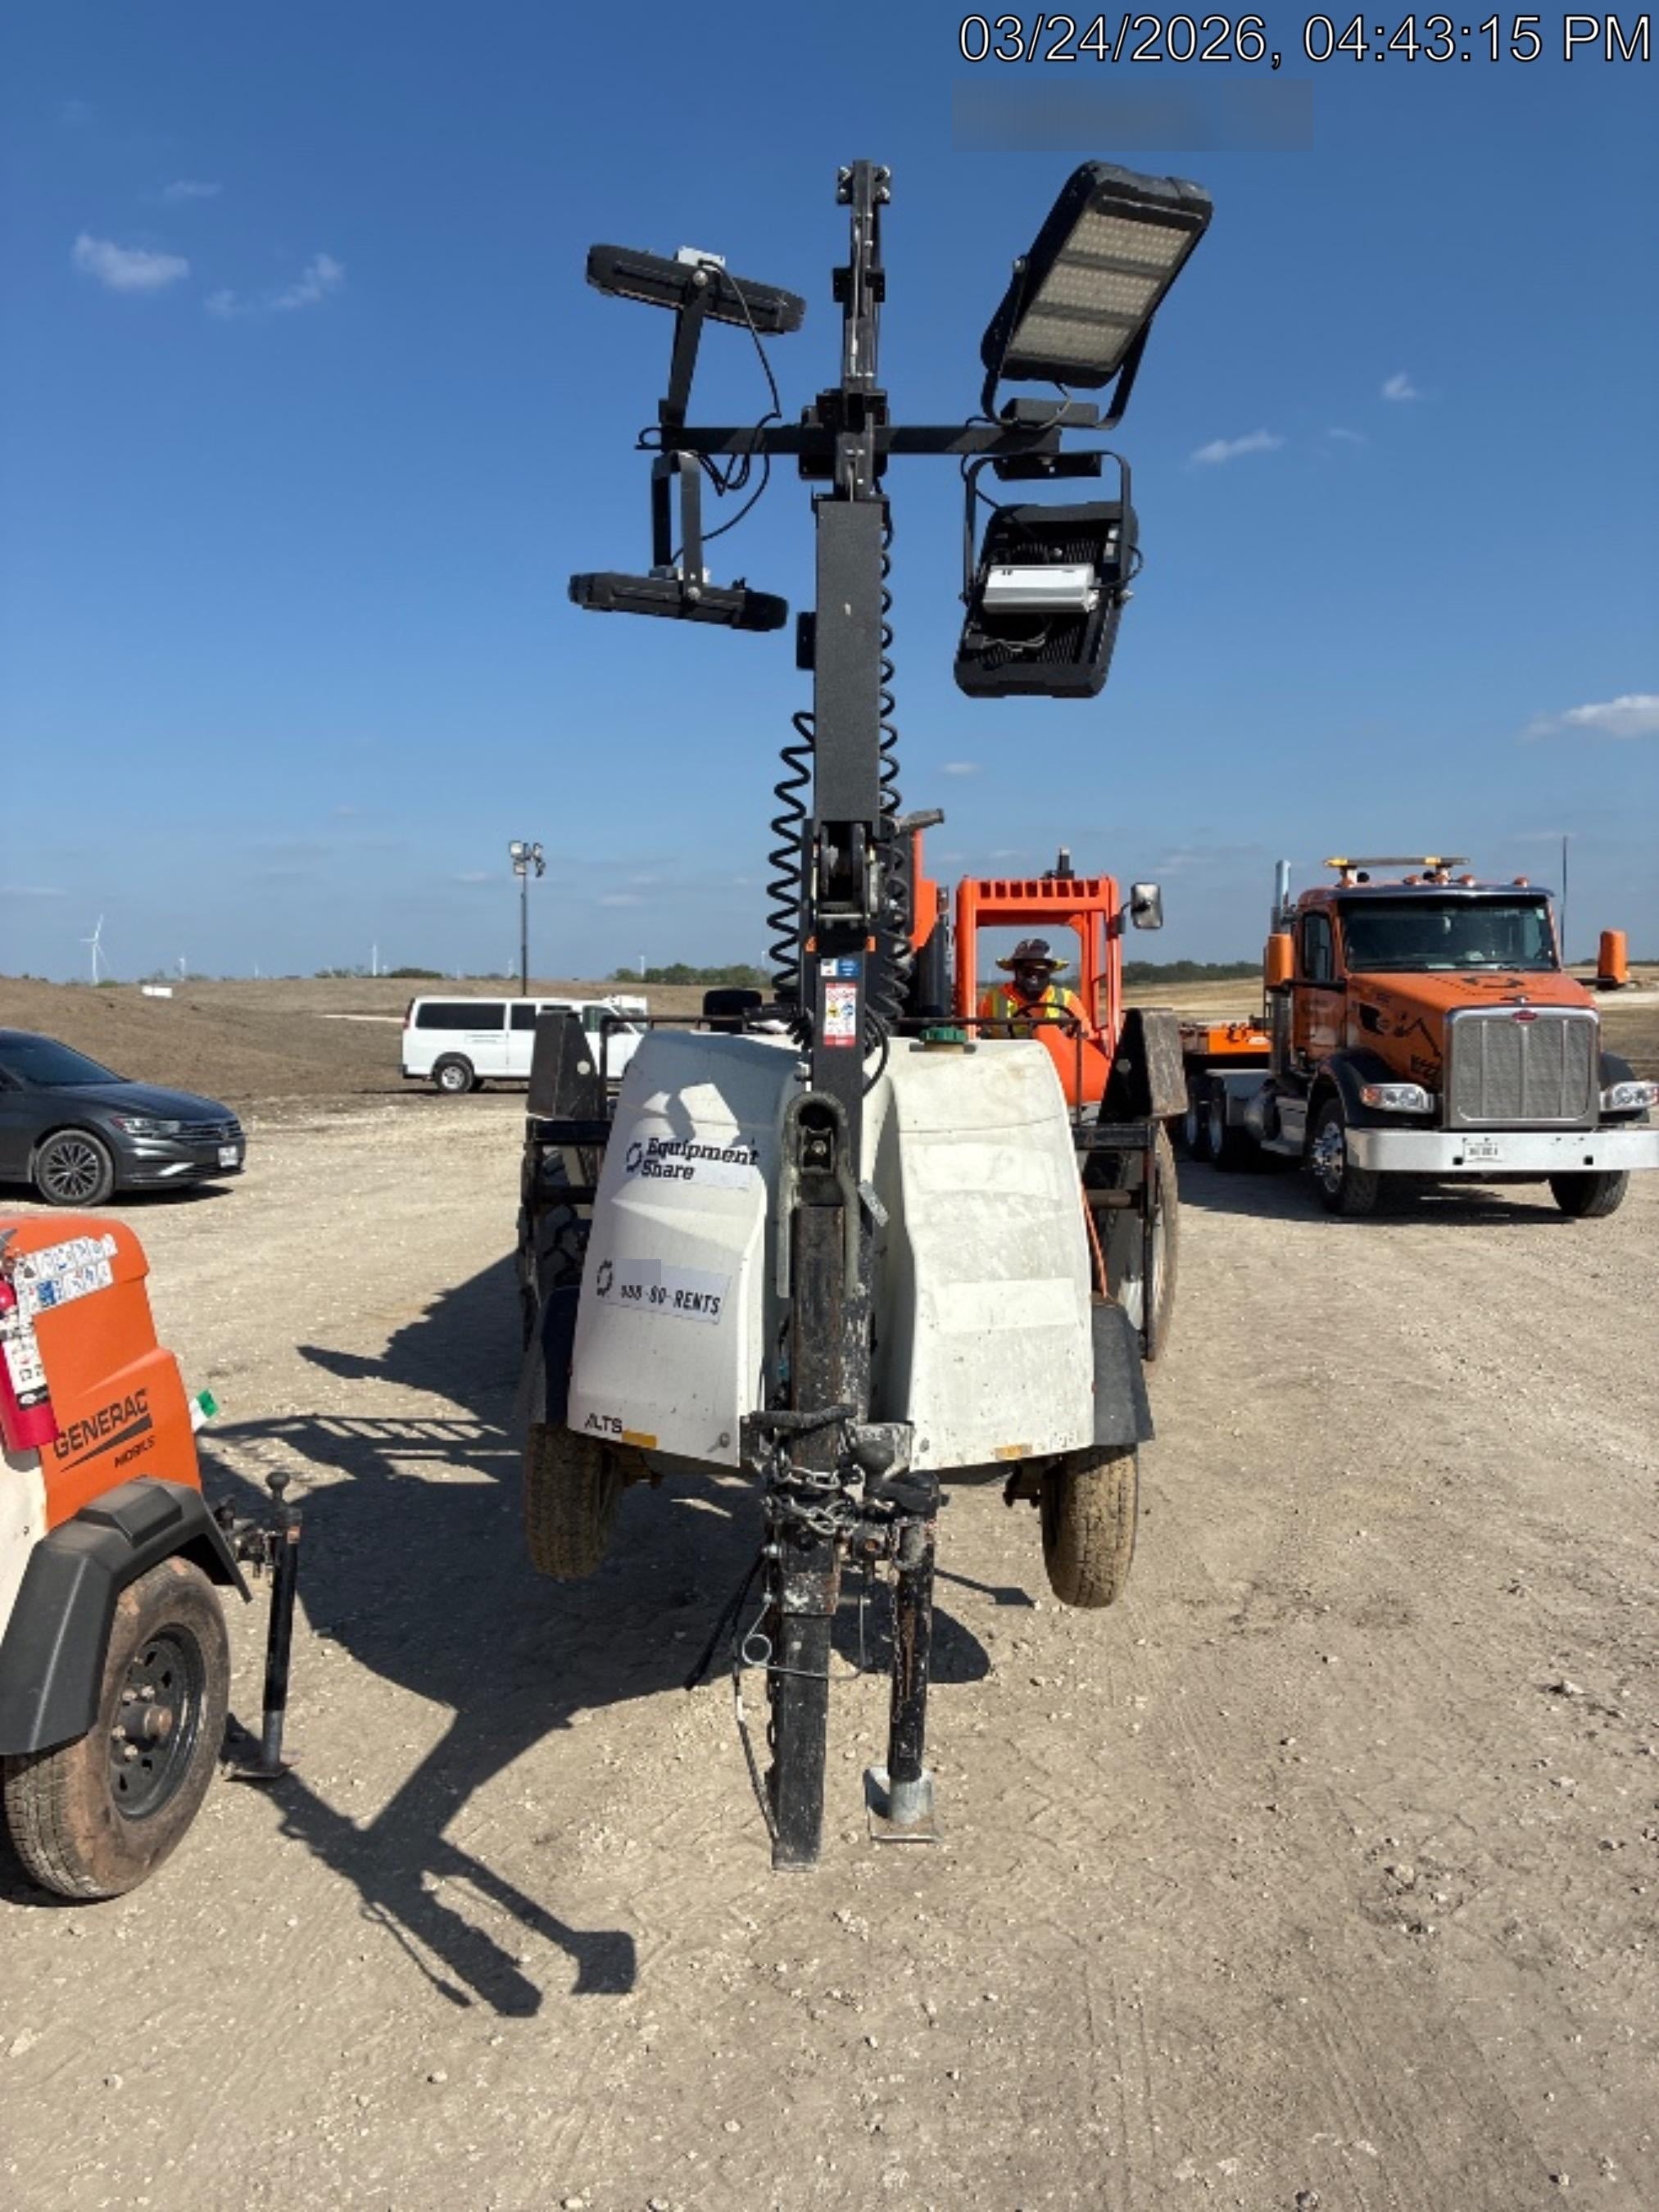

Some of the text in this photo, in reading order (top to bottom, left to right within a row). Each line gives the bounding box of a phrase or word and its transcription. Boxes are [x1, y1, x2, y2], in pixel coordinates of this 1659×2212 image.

[646, 1137, 759, 1165] Equipment
[641, 1159, 695, 1180] Share
[53, 1388, 148, 1460] GENERAC
